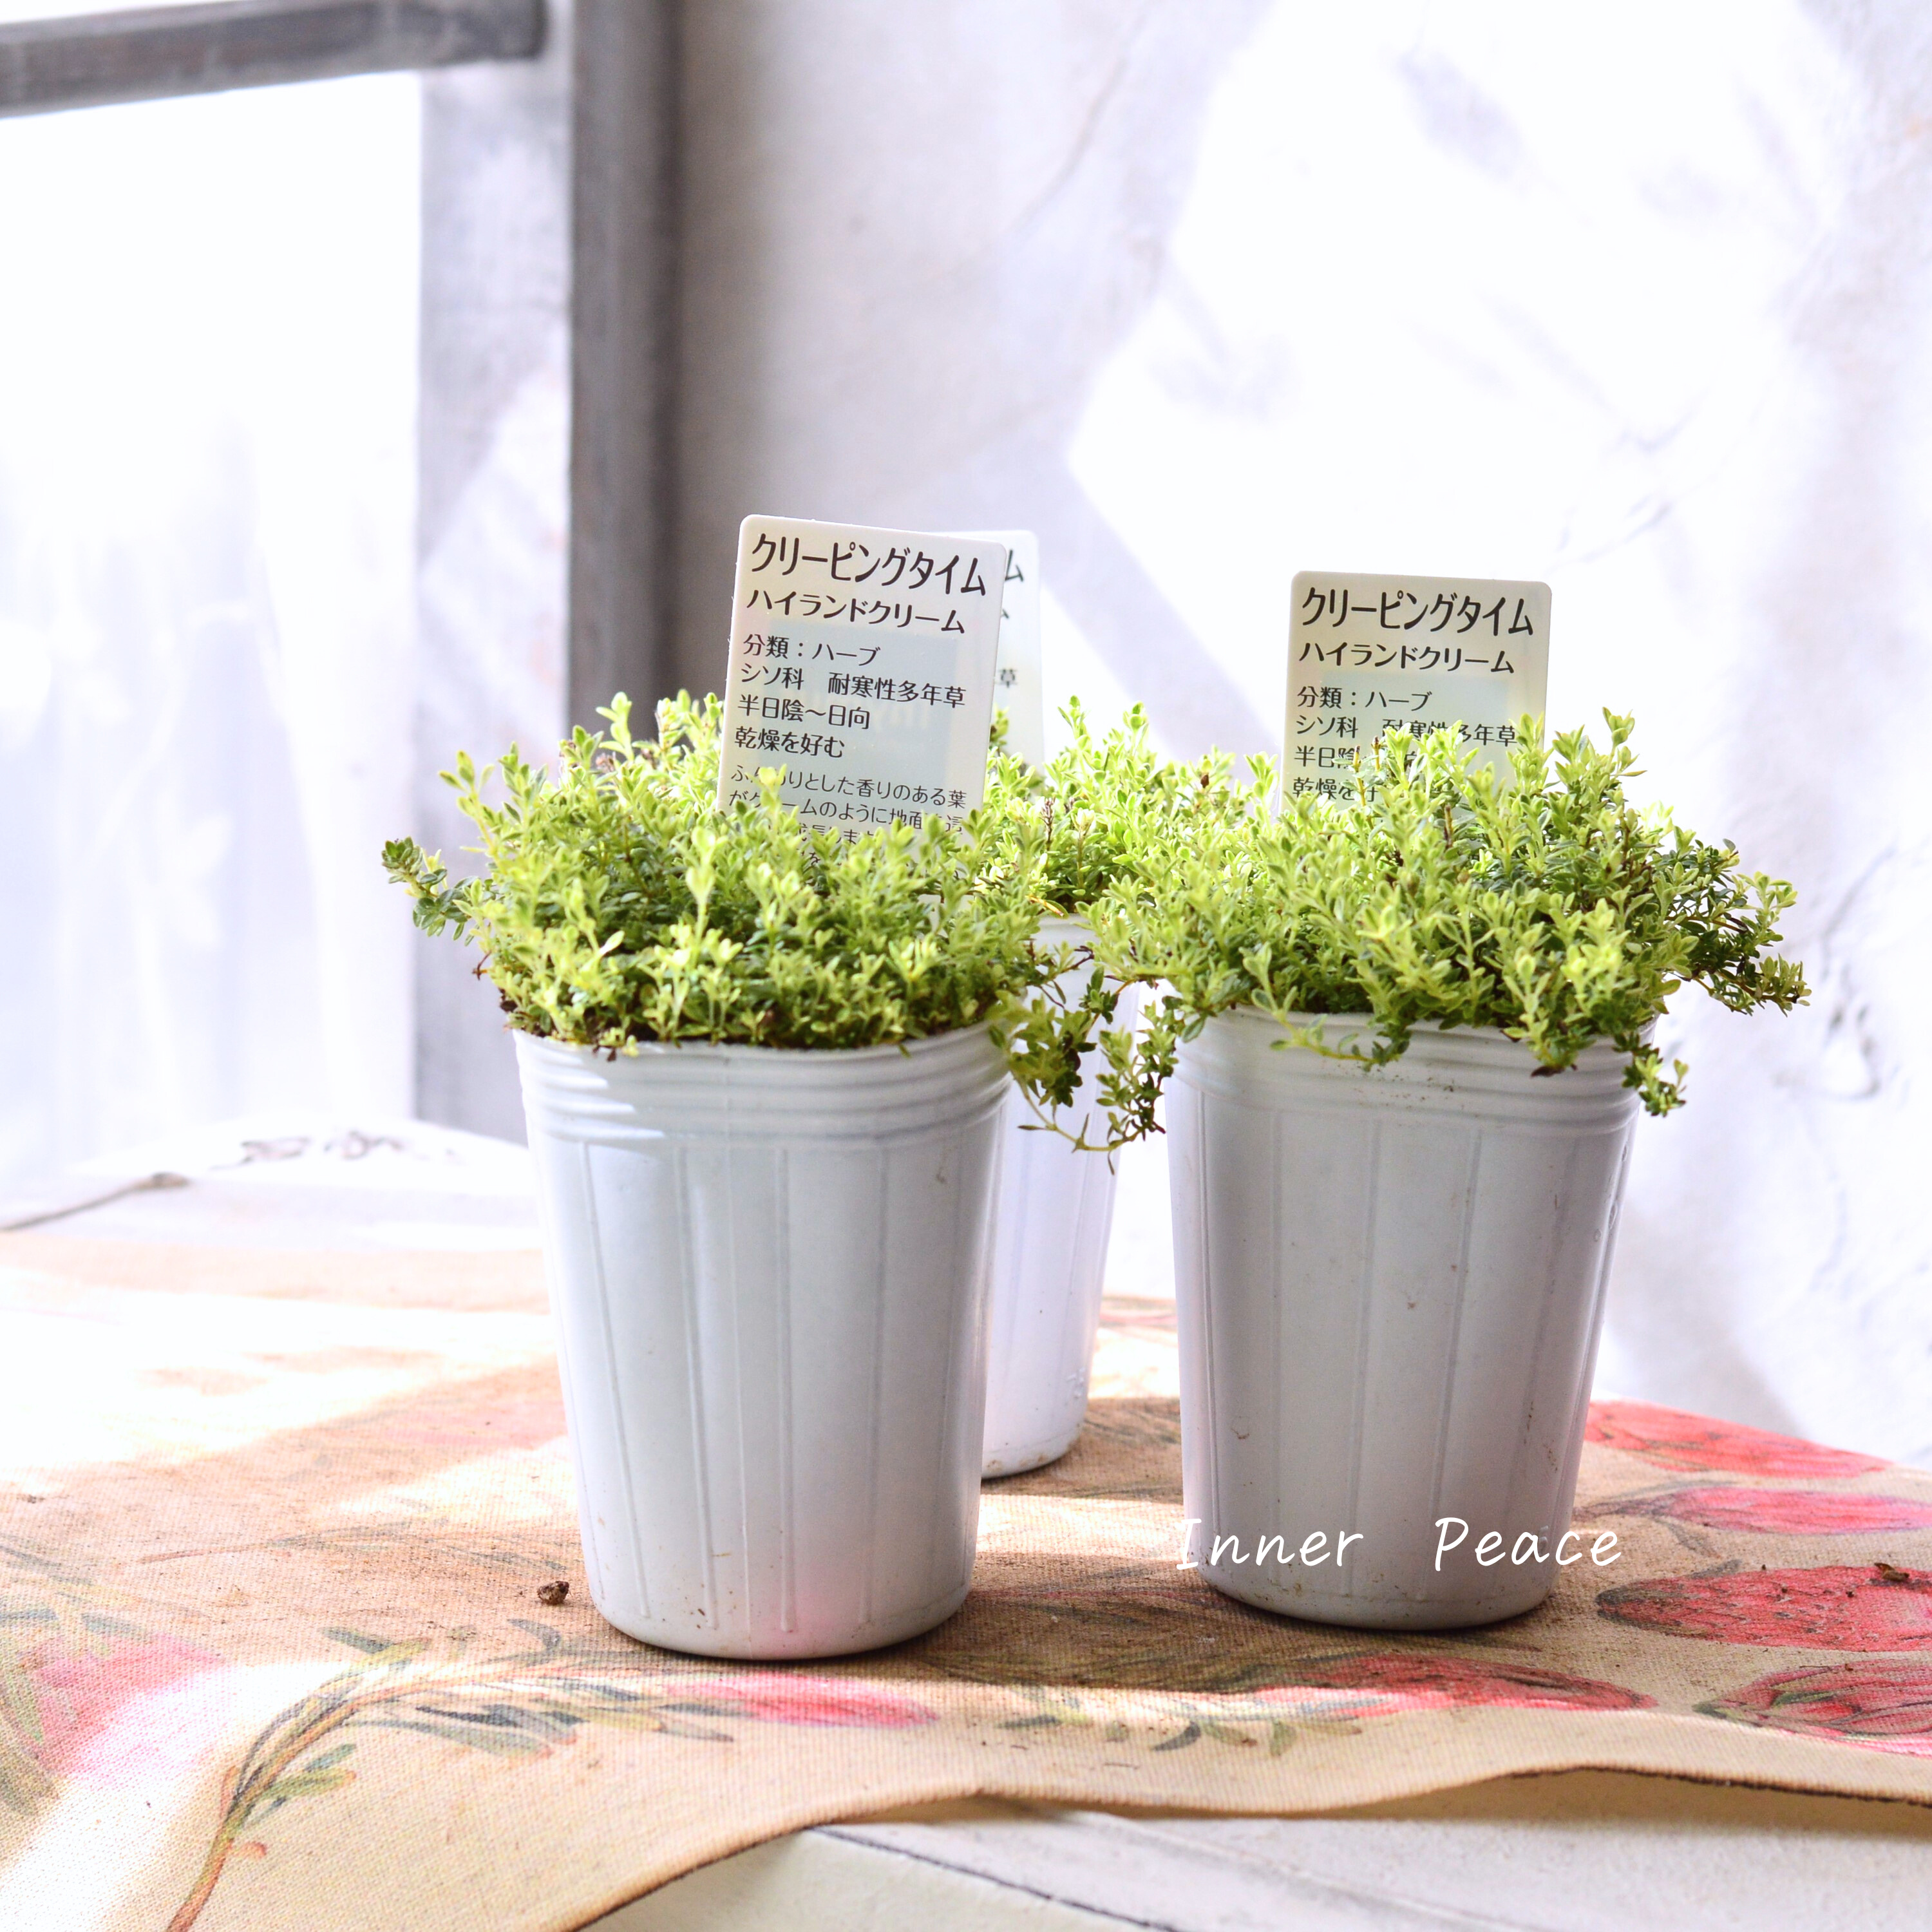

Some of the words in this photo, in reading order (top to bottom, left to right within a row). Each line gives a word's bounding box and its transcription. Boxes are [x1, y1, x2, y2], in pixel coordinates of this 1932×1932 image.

[752, 533, 986, 596] クリーピングタイム
[746, 589, 965, 634] ハイランドクリーム
[1302, 587, 1534, 636] クリーピングタイム
[743, 634, 882, 667] 分類：ハーブ
[1298, 642, 1515, 674] ハイランドクリーム
[741, 663, 805, 690] シソ科
[828, 671, 967, 708] 耐寒性多年草
[1296, 685, 1432, 712] 分類：ハーブ
[734, 725, 845, 758] 乾燥を好む
[1296, 715, 1359, 739] シソ科
